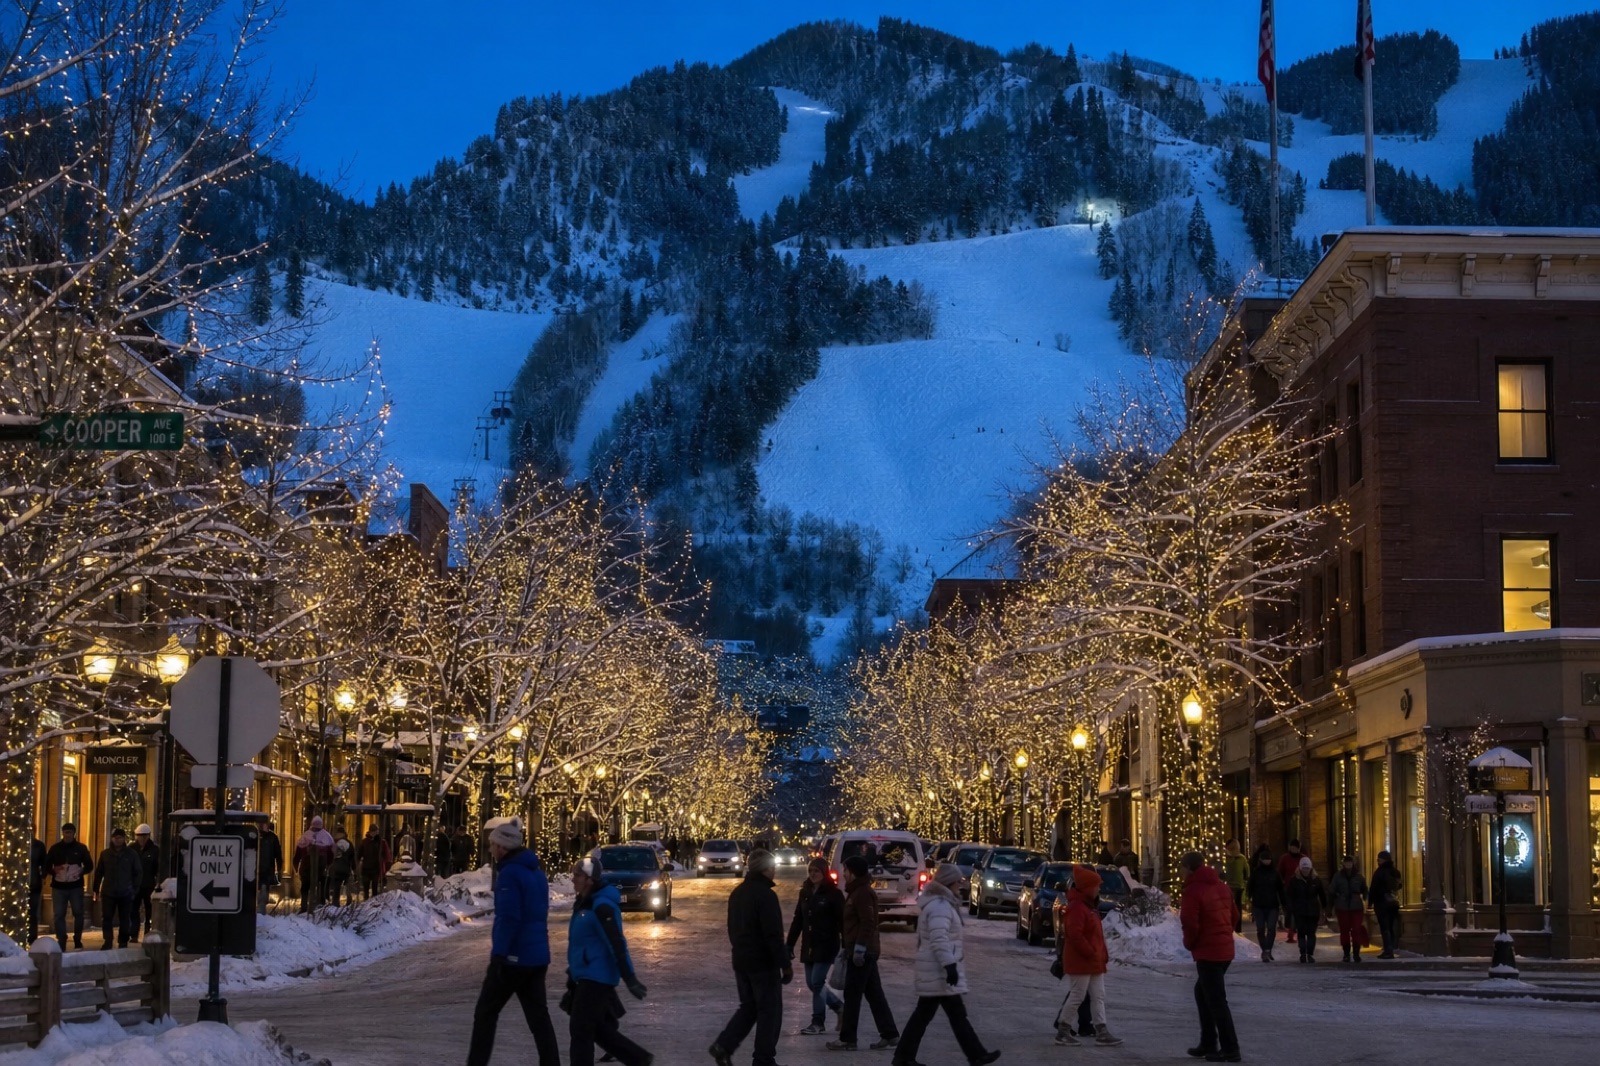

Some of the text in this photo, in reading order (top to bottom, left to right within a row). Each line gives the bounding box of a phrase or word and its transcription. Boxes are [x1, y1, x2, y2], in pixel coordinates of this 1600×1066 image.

[153, 418, 172, 430] AVE
[63, 419, 142, 443] COOPER
[150, 433, 176, 444] 100 E
[93, 755, 139, 765] MONCLER
[199, 844, 233, 857] WALK
[199, 861, 232, 874] ONLY
